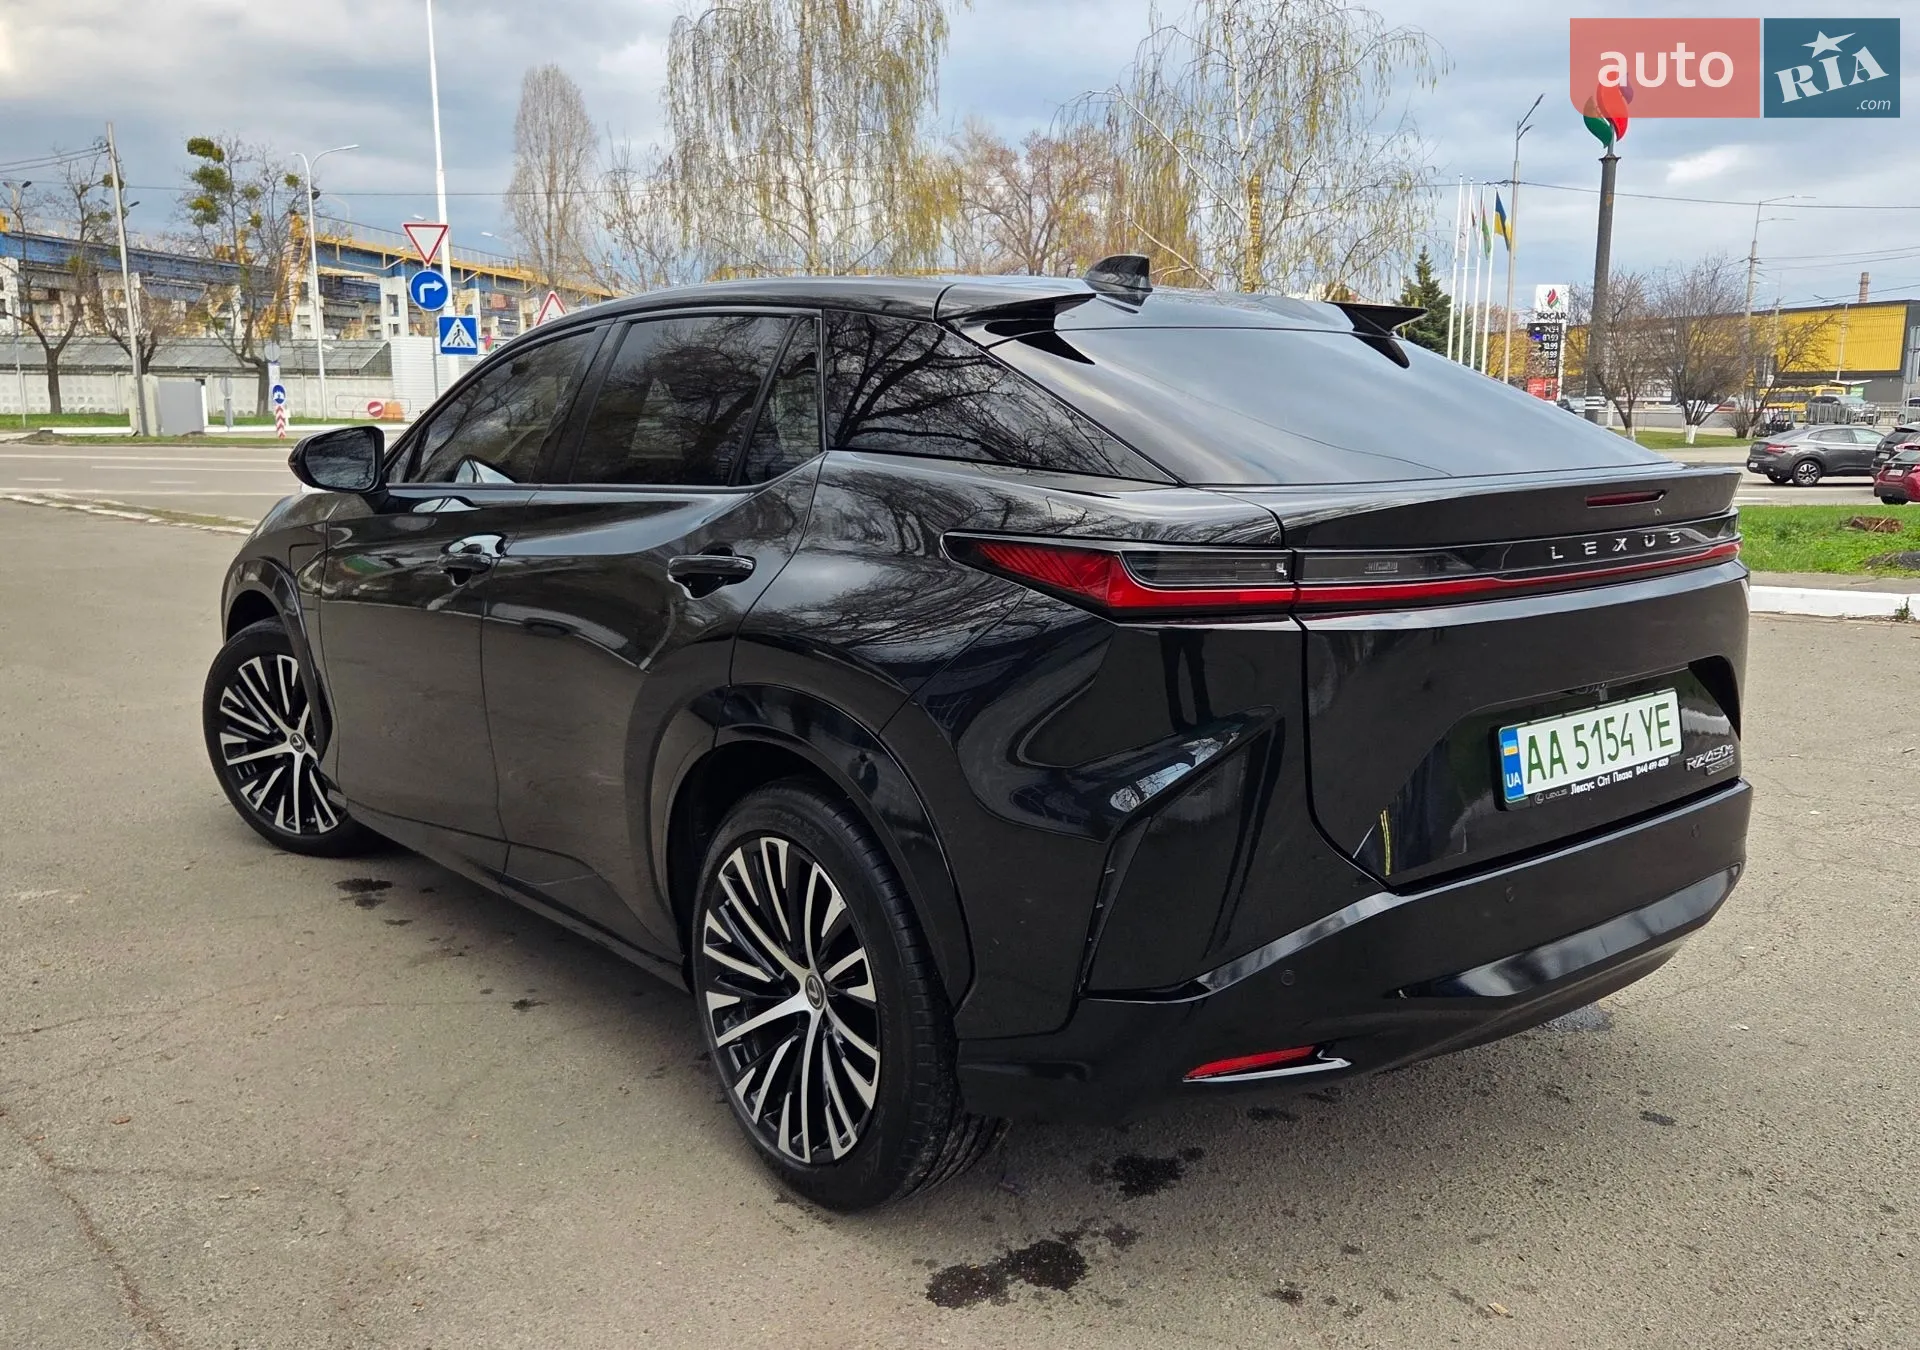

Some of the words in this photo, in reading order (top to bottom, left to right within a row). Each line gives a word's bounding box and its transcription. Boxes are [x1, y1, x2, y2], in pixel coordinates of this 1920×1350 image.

[1536, 312, 1567, 320] SOCAR
[1550, 531, 1682, 560] LEXUS
[1527, 730, 1568, 784] AA
[1573, 712, 1635, 770] 5154
[1639, 703, 1673, 752] YE
[1506, 771, 1522, 788] UA
[1571, 780, 1595, 795] Лексус
